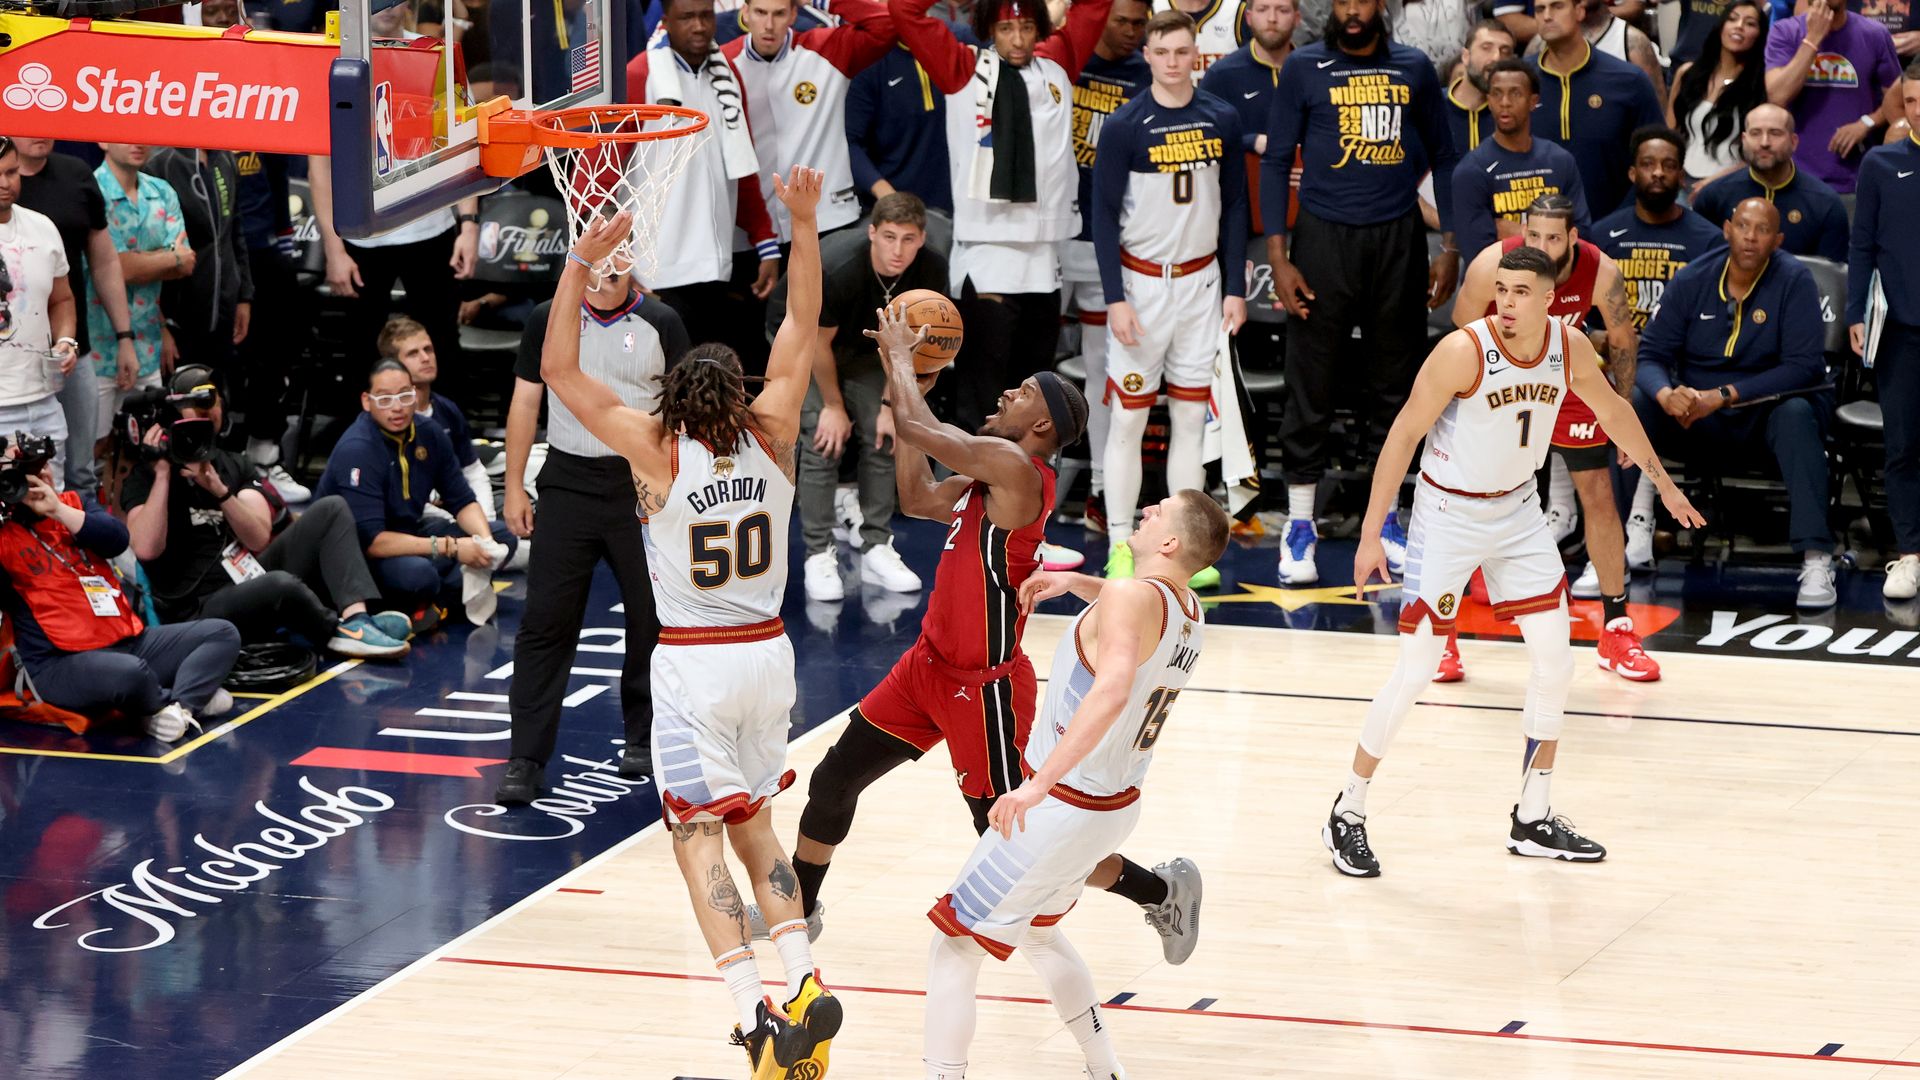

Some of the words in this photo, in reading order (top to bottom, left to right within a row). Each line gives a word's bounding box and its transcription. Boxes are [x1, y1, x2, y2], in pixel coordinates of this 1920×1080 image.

[1328, 84, 1410, 105] NUGGETS
[1348, 74, 1389, 86] DENVER
[1072, 85, 1130, 114] NUGGE
[1165, 129, 1204, 144] DENVER
[1361, 105, 1402, 141] NBA
[1148, 138, 1223, 164] NUGGETS
[1330, 133, 1406, 169] Finals
[1173, 170, 1194, 205] 0
[1510, 176, 1545, 191] DENVER
[486, 225, 569, 264] Finals
[1631, 248, 1670, 261] DENVER
[1486, 351, 1499, 363] 6
[1548, 354, 1562, 363] WU
[1485, 383, 1560, 411] DENVER
[1516, 408, 1533, 448] 1
[687, 477, 767, 514] GORDON
[689, 510, 772, 590] 50
[1132, 686, 1182, 752] 15
[33, 775, 395, 953] Michelob
